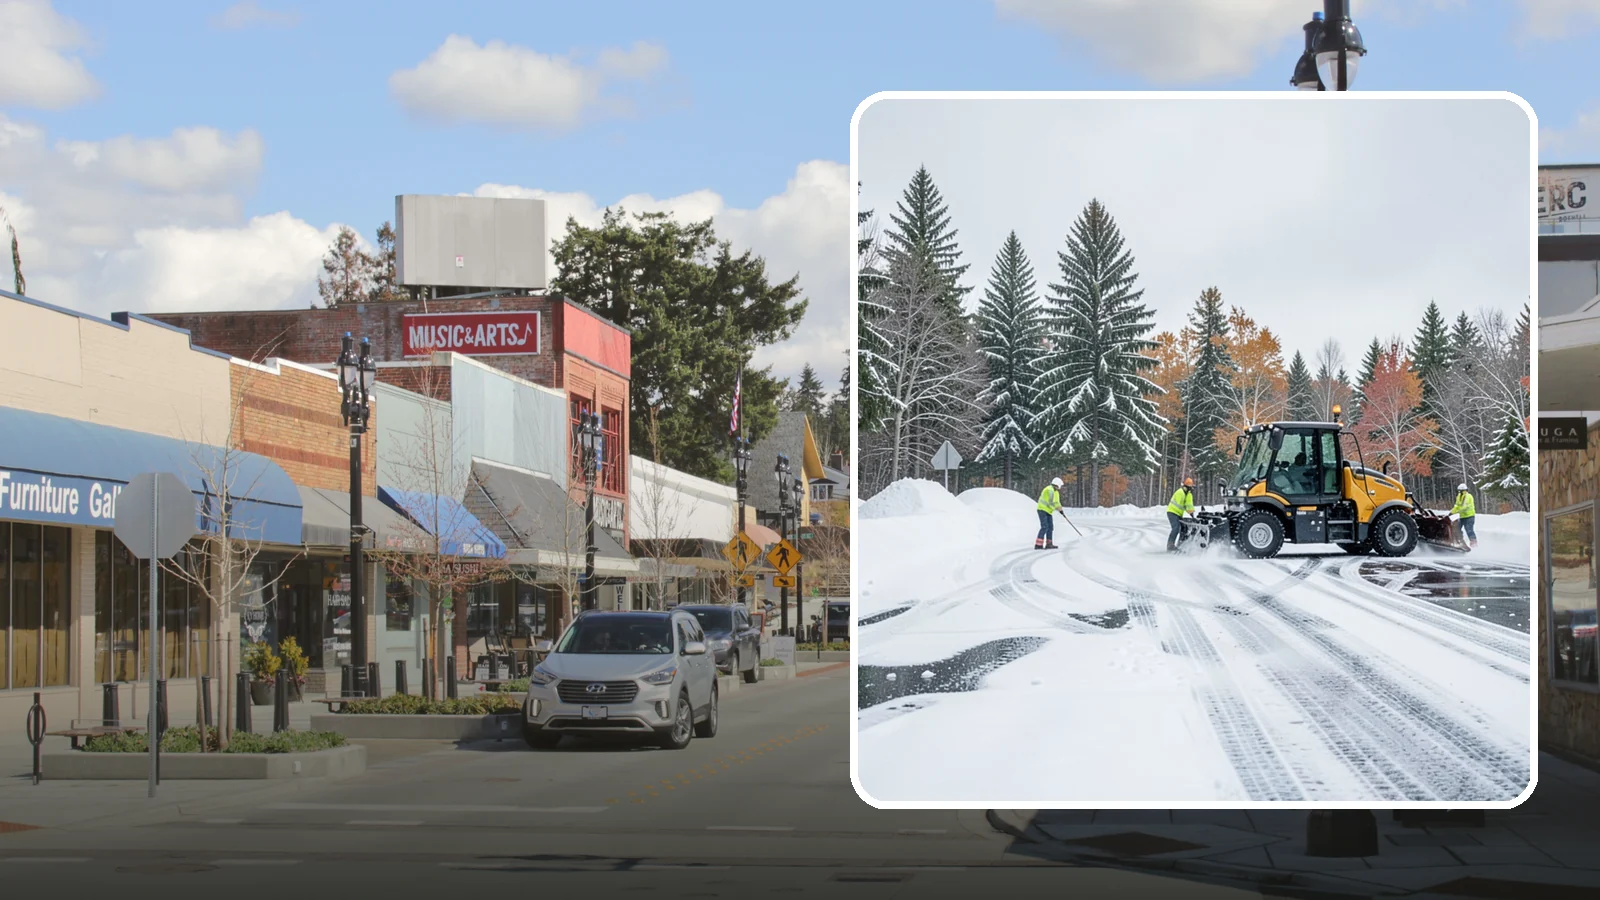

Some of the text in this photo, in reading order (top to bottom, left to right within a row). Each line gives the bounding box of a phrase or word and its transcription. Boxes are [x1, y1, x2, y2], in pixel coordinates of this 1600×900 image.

[1540, 428, 1577, 436] UGA
[0, 471, 80, 516] Furniture
[454, 563, 480, 574] SUSHI
